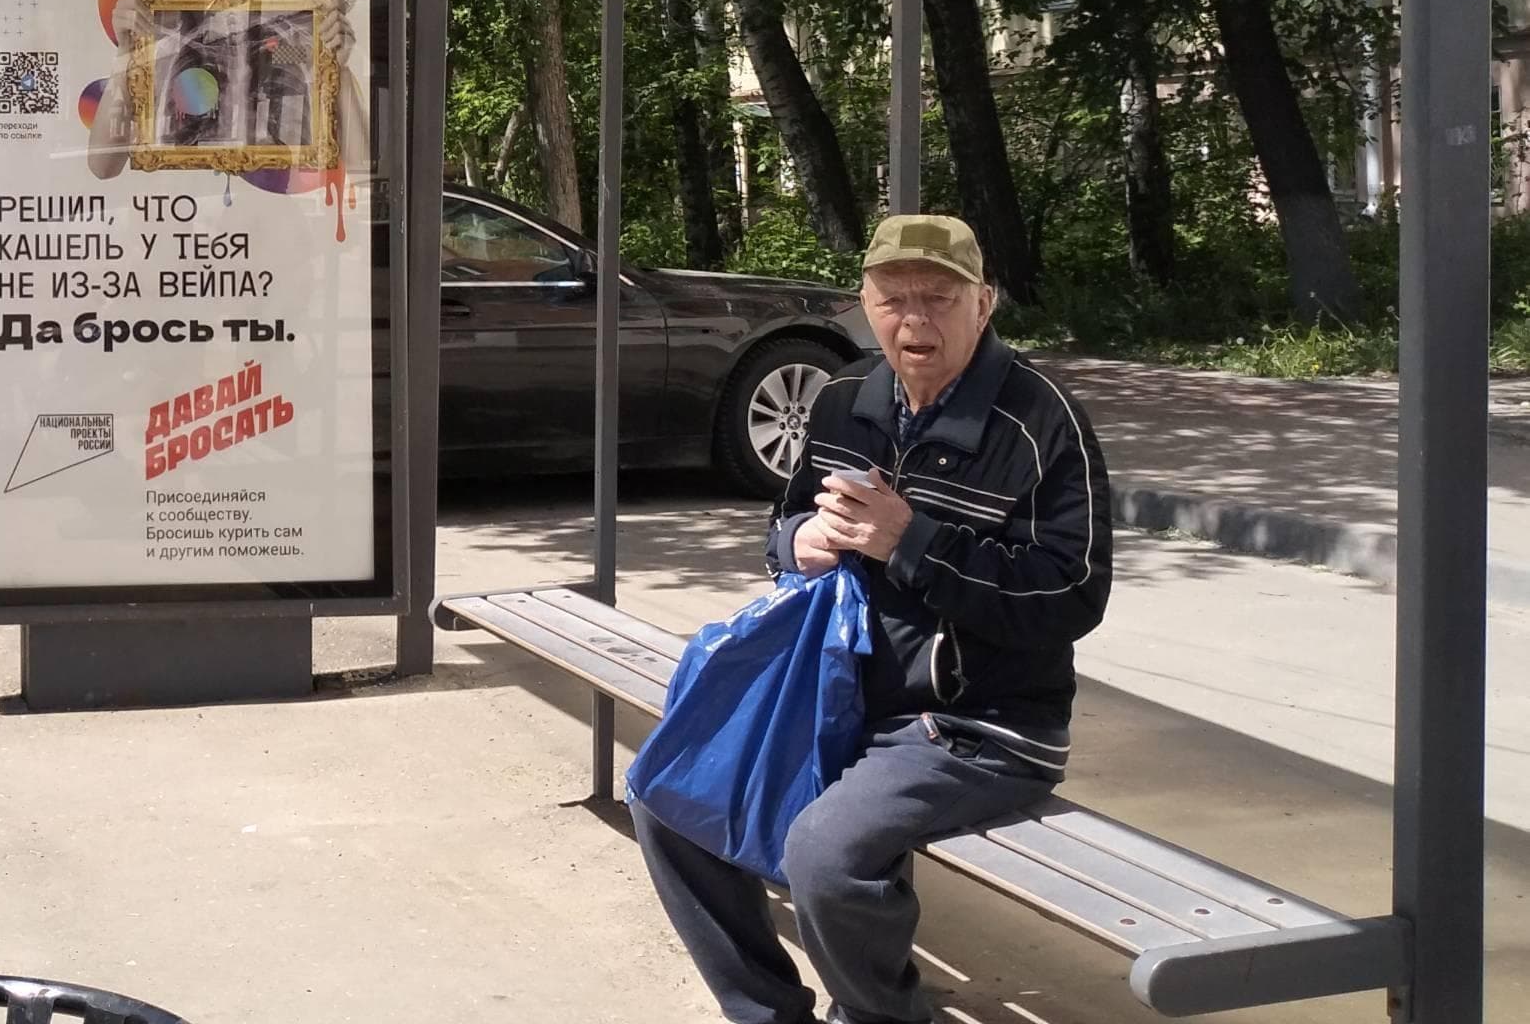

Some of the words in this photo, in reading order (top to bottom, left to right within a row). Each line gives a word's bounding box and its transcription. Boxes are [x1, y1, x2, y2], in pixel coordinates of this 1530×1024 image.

[132, 194, 198, 223] ЧТО
[140, 233, 158, 261] У
[52, 271, 142, 299] ИЗ-ЗА
[159, 264, 274, 298] ВЕЙПА?
[73, 312, 214, 352] брось
[222, 319, 296, 343] ты.
[145, 359, 262, 445] ДАВАЙ
[39, 416, 111, 429] НАЦИОНАЛЬНЫЕ
[70, 428, 111, 440] ПРОЕКТЫ
[145, 394, 295, 481] БРОСАТЬ
[77, 439, 112, 451] РОССИИ
[145, 490, 266, 507] Присоединяйся
[146, 512, 154, 522] к
[158, 508, 252, 526] сообществу.
[146, 527, 214, 543] Бросишь
[218, 528, 270, 544] курить
[274, 528, 303, 539] сам
[146, 548, 155, 559] и
[159, 546, 214, 562] другим
[218, 543, 304, 557] поможешь.
